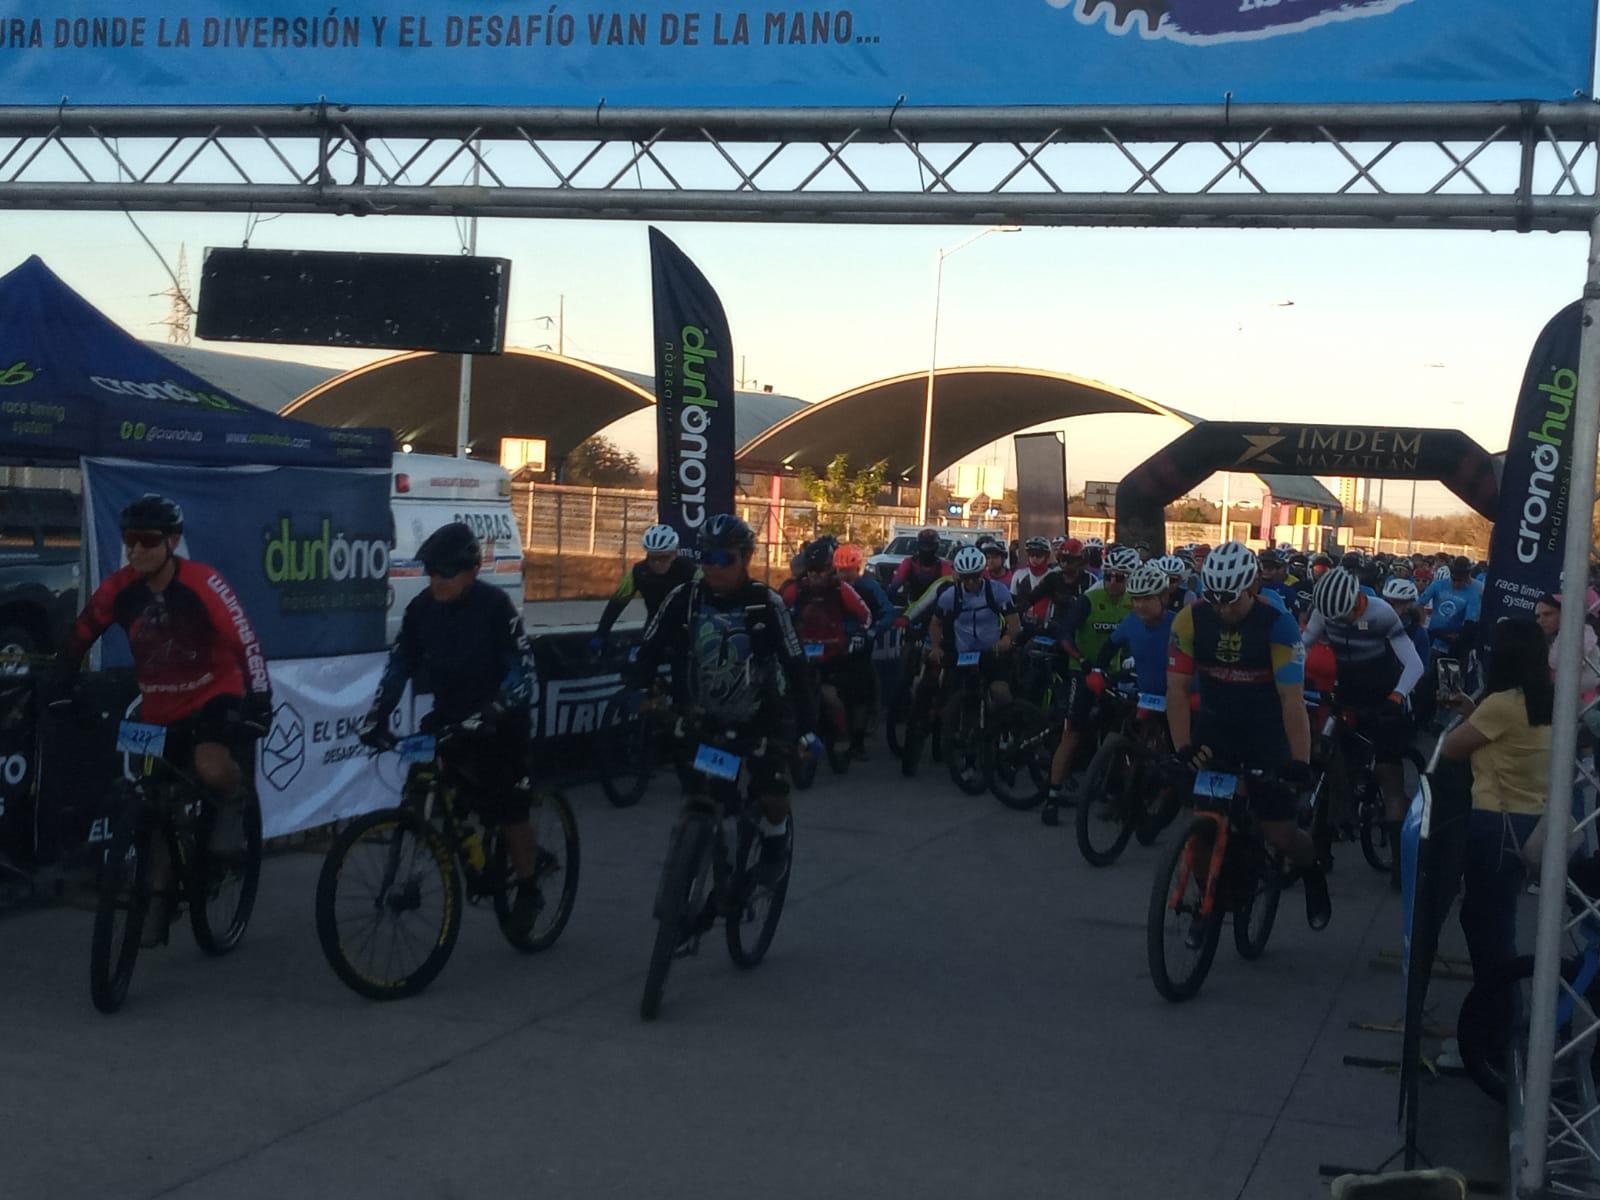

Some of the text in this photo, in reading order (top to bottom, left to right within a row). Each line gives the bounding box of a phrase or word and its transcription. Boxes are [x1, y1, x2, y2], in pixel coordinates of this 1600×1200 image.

[53, 17, 146, 48] DONDE
[156, 17, 191, 48] LA
[202, 7, 360, 48] DIVERSIÓN
[372, 16, 388, 48] Y
[399, 16, 433, 48] EL
[445, 5, 575, 47] DESAFÍO
[588, 13, 647, 46] VAN
[660, 13, 700, 46] DE
[713, 12, 750, 46] LA
[763, 10, 880, 45] MANO...
[1298, 427, 1422, 455] IMDEM
[1516, 366, 1578, 564] cronohub
[1495, 578, 1520, 593] race
[312, 719, 332, 744] EL
